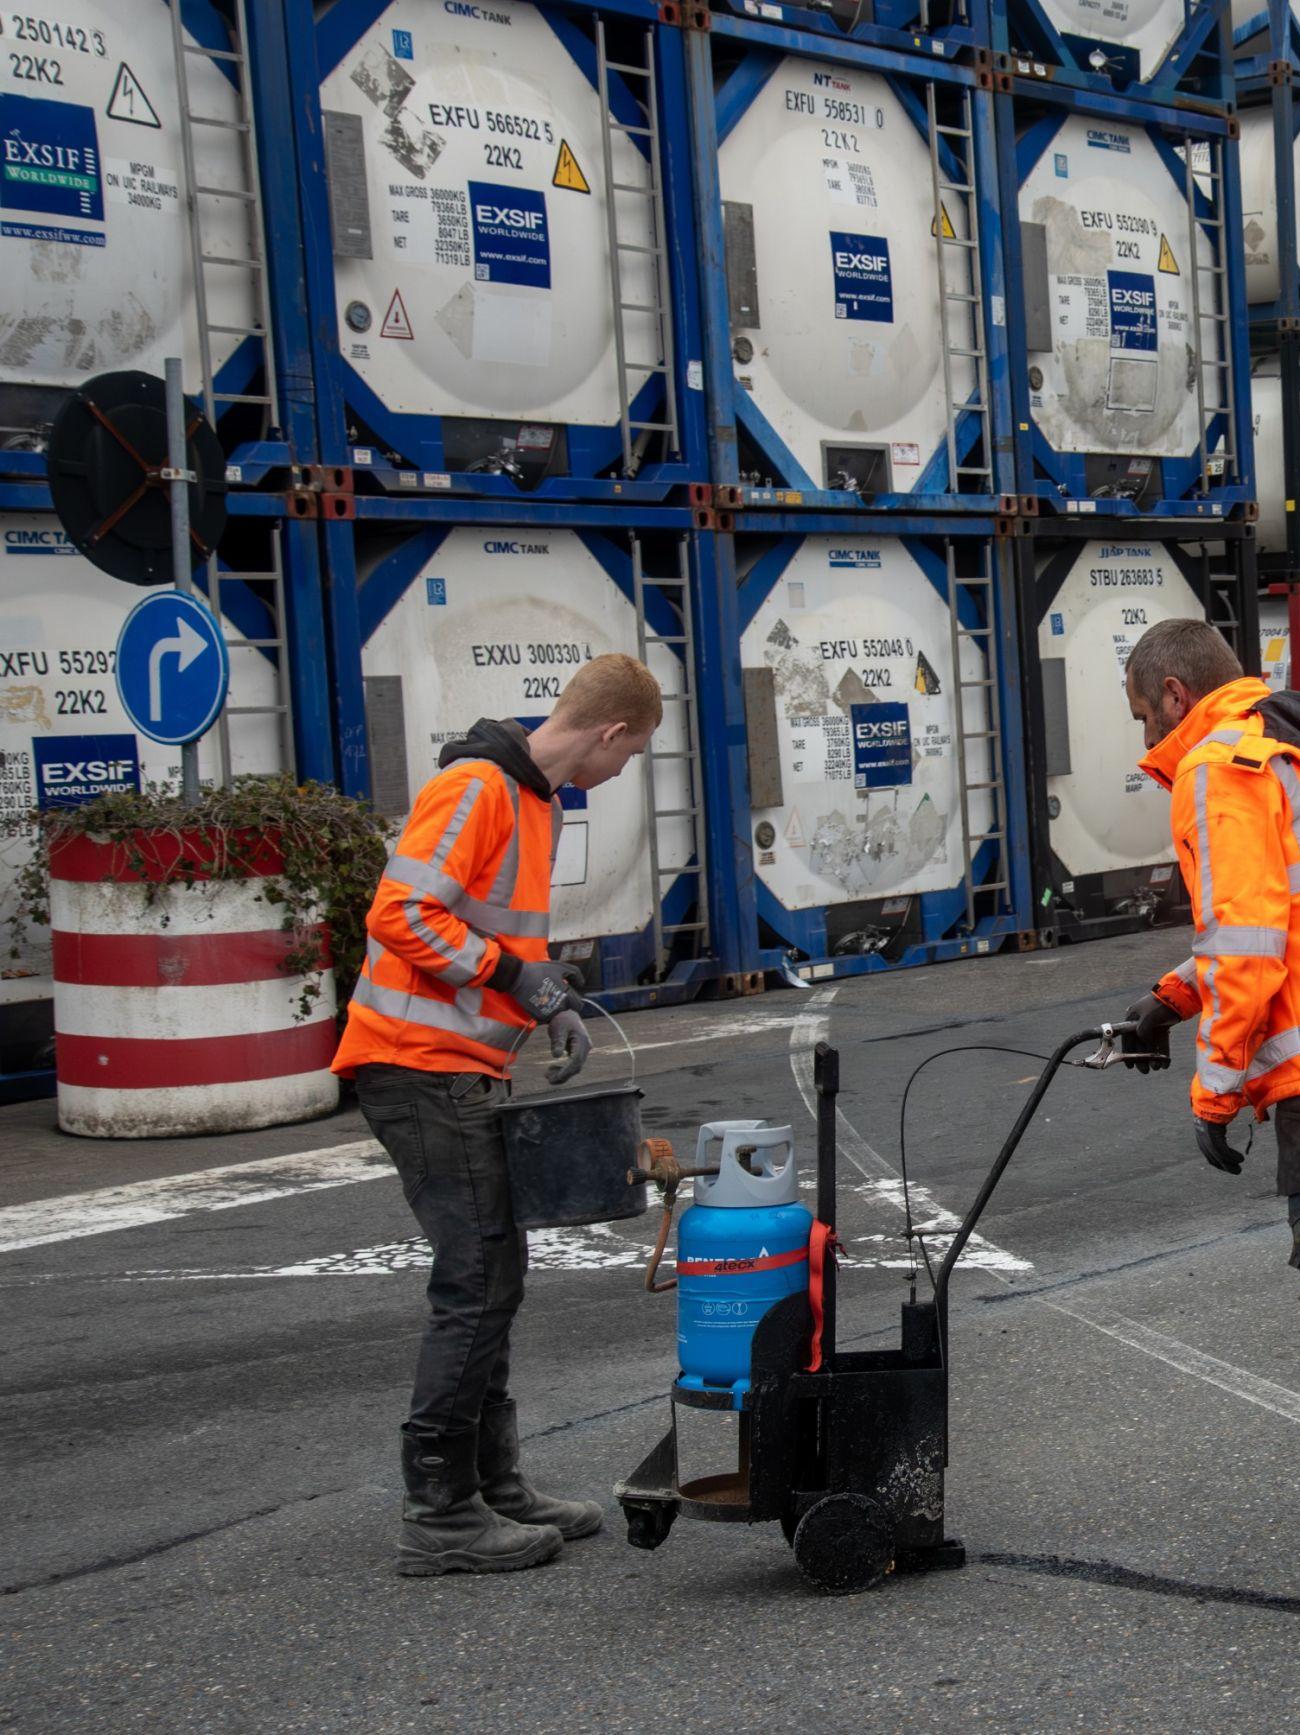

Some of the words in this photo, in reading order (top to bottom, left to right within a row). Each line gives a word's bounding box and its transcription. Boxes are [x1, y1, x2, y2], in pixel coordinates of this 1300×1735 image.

[444, 1, 480, 19] CIMC
[481, 11, 511, 26] TANK
[12, 14, 90, 53] 250142
[93, 31, 106, 56] 3
[9, 52, 64, 85] 22K2
[814, 73, 832, 87] NT
[785, 90, 815, 115] EXFU
[824, 98, 865, 125] 558531
[876, 107, 884, 129] 0
[429, 103, 480, 130] EXFU
[486, 111, 541, 141] 566522
[545, 122, 554, 144] 5
[821, 128, 860, 153] 22K2
[4, 138, 80, 170] EXSIF
[484, 144, 524, 171] 22K2
[6, 165, 91, 189] WORLDWIDE
[475, 204, 543, 229] EXSIF
[1081, 210, 1113, 229] EXFU
[1115, 213, 1150, 236] 552390
[393, 236, 408, 249] NET
[458, 229, 469, 241] LB
[477, 225, 545, 242] WORLDWIDE
[479, 250, 548, 266] www.exsif.com
[1115, 240, 1141, 260] 22K2
[459, 255, 471, 267] LB
[835, 251, 888, 272] EXSIF
[838, 269, 889, 283] WORLDWIDE
[1112, 288, 1153, 307] EXSIF
[4, 531, 52, 544] CIMC
[484, 541, 519, 554] CIMC
[520, 543, 550, 556] TANK
[828, 549, 854, 560] CIMC
[855, 550, 881, 561] TANK
[1126, 548, 1152, 557] TANK
[1089, 568, 1118, 587] STBU
[1119, 568, 1154, 587] 263683
[1156, 567, 1164, 587] 5
[1121, 608, 1149, 625] 22K2
[471, 645, 522, 667] EXXU
[528, 644, 580, 665] 300330
[585, 645, 594, 661] 4
[820, 640, 859, 660] EXFU
[863, 639, 904, 659] 552048
[905, 638, 914, 658] 0
[0, 651, 48, 678] XFU
[59, 650, 117, 675] 55292
[523, 677, 561, 699] 22K2
[862, 668, 893, 688] 22K2
[54, 690, 108, 715] 22K2
[430, 732, 446, 745] MAX
[856, 720, 907, 740] EXSIF
[792, 739, 806, 751] TARE
[858, 737, 909, 750] WORLDWIDE
[42, 761, 134, 785] EXSIF
[44, 783, 135, 798] WORLDWIDE
